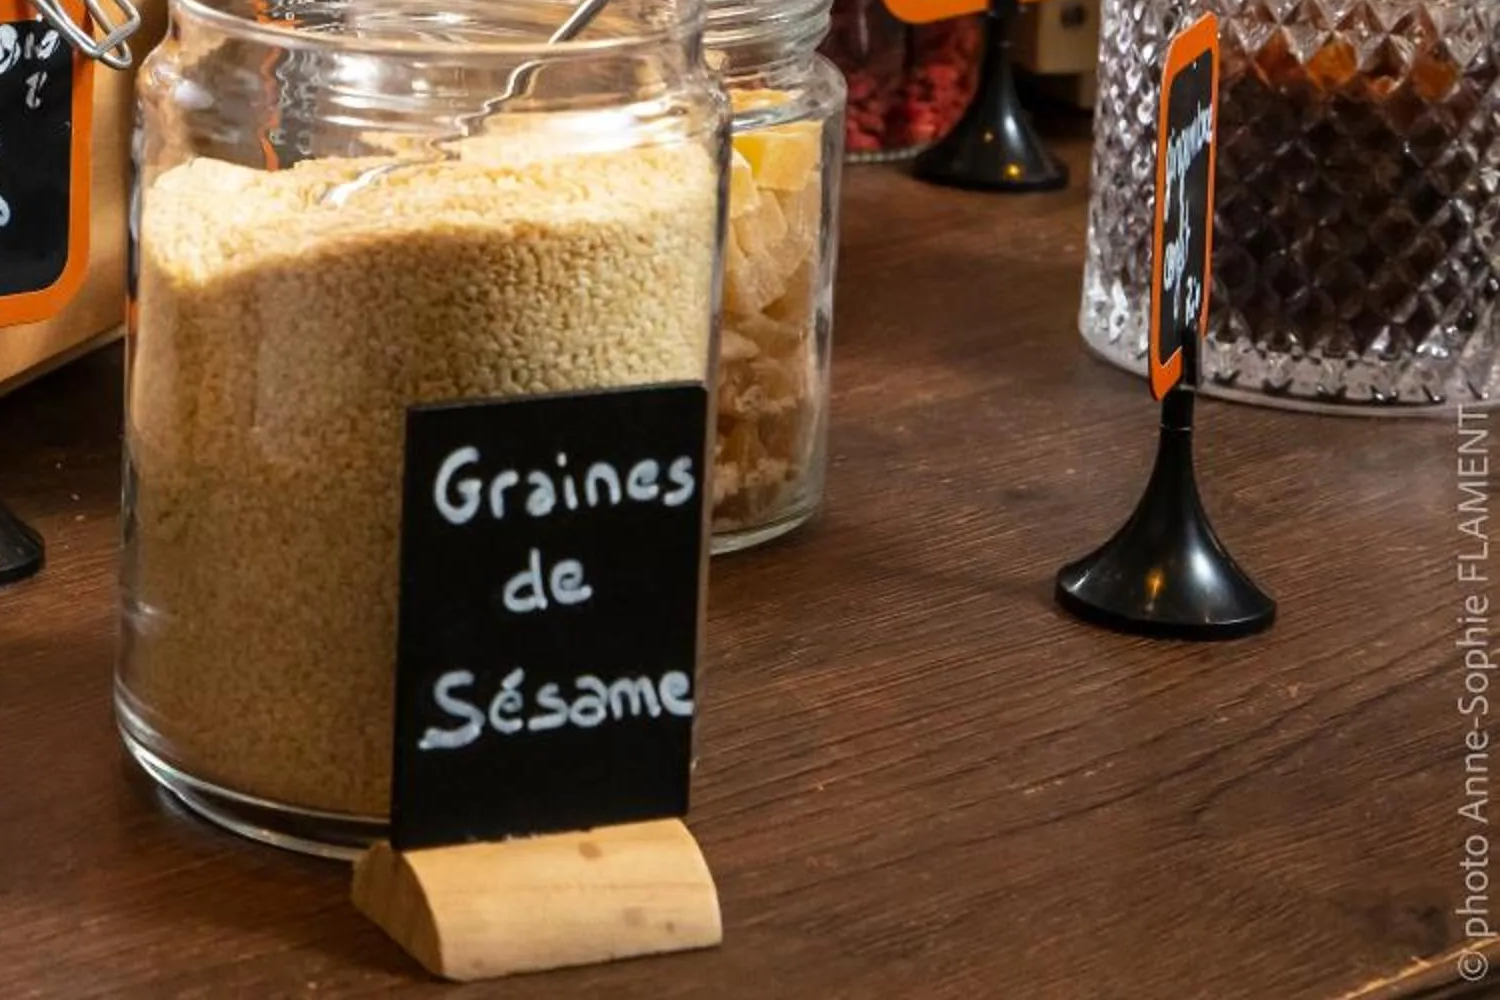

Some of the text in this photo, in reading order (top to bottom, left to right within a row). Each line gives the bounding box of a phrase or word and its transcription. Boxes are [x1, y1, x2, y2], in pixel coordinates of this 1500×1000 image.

[433, 445, 696, 525] Graines
[503, 547, 594, 613] de
[417, 667, 695, 751] Sésame
